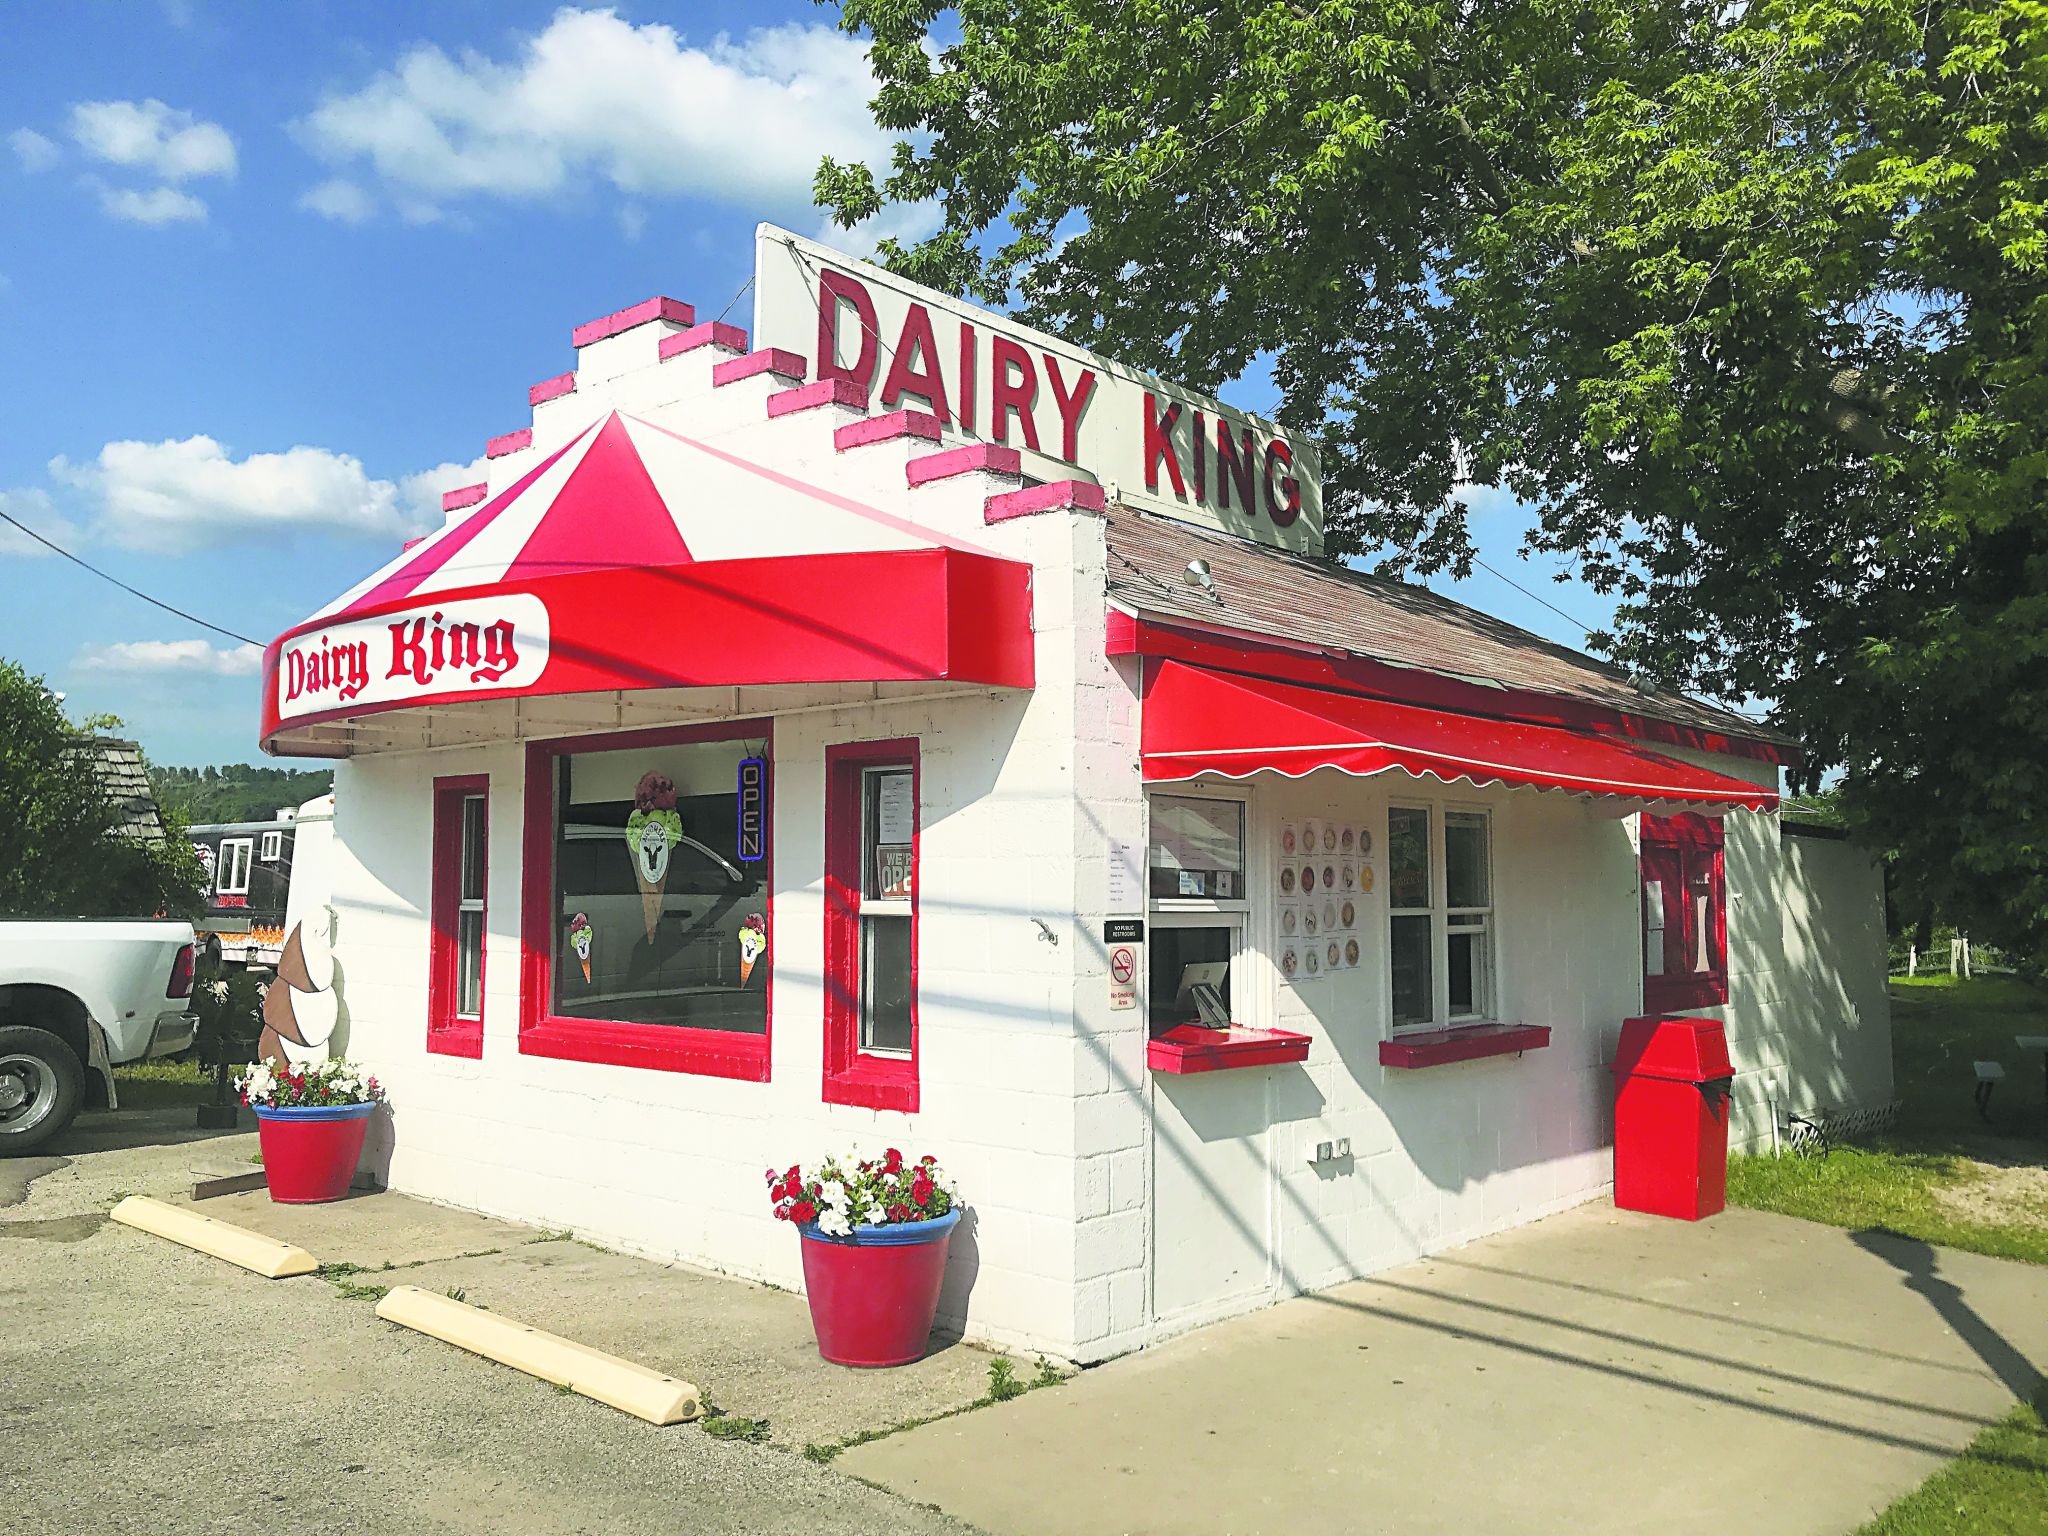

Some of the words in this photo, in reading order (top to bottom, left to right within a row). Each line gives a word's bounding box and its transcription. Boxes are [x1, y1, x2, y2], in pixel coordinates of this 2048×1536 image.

[816, 267, 1096, 463] DAIRY
[1143, 391, 1301, 527] KING
[285, 634, 369, 704] Dairy
[385, 611, 519, 685] King
[743, 766, 759, 855] OPEN
[881, 865, 913, 893] OPE
[886, 852, 913, 866] WE'R
